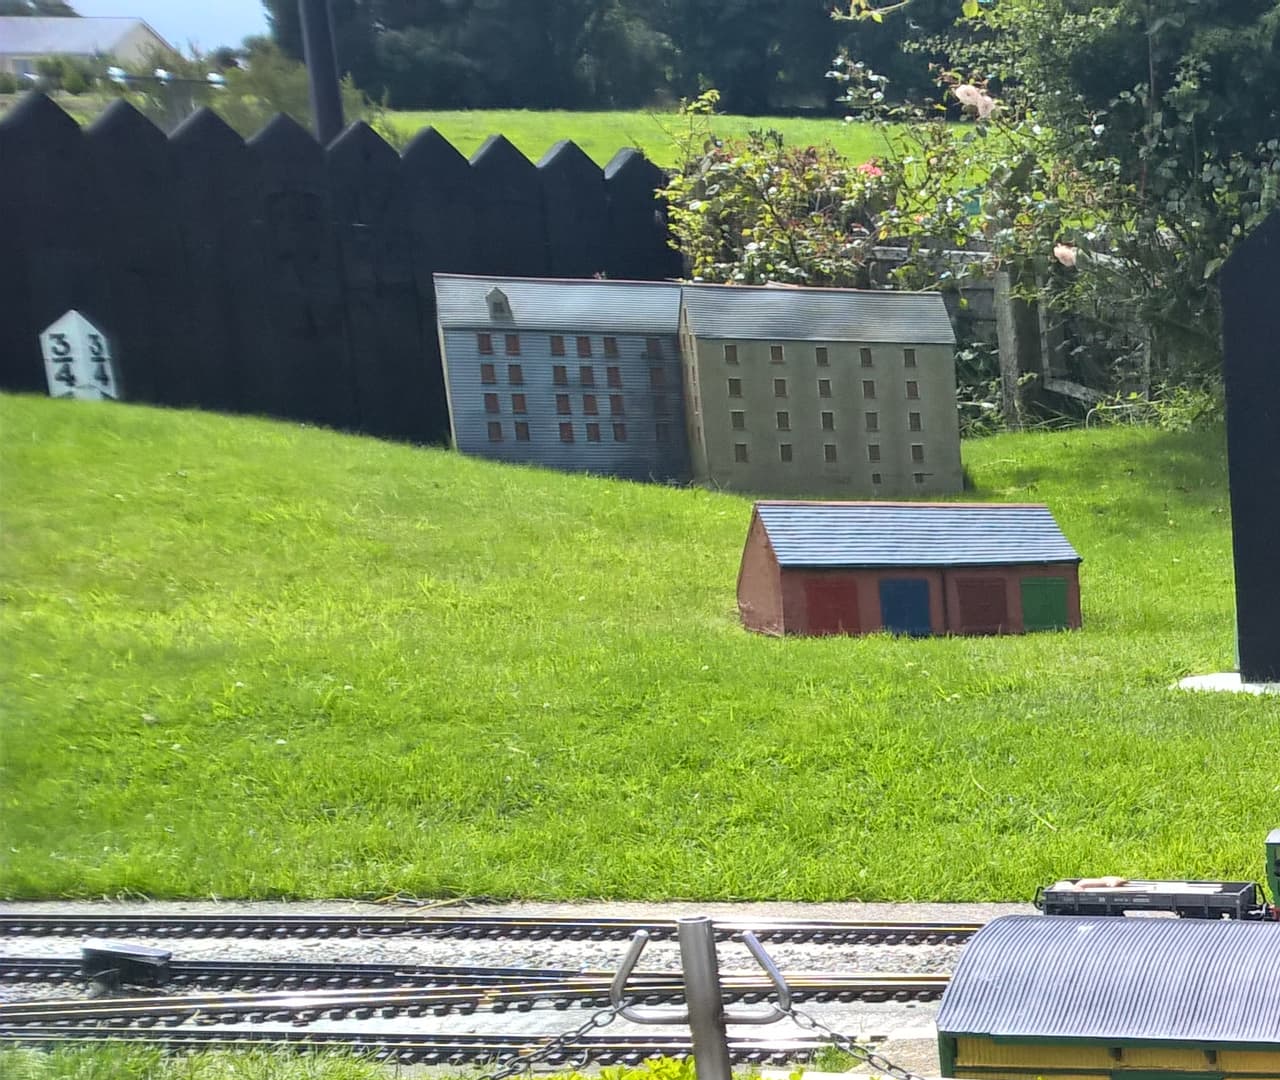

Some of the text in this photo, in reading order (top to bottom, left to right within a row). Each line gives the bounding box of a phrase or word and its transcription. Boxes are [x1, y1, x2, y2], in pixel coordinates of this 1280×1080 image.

[49, 333, 71, 356] 3
[87, 334, 104, 355] 3
[54, 362, 76, 387] 4
[94, 362, 109, 386] 4
